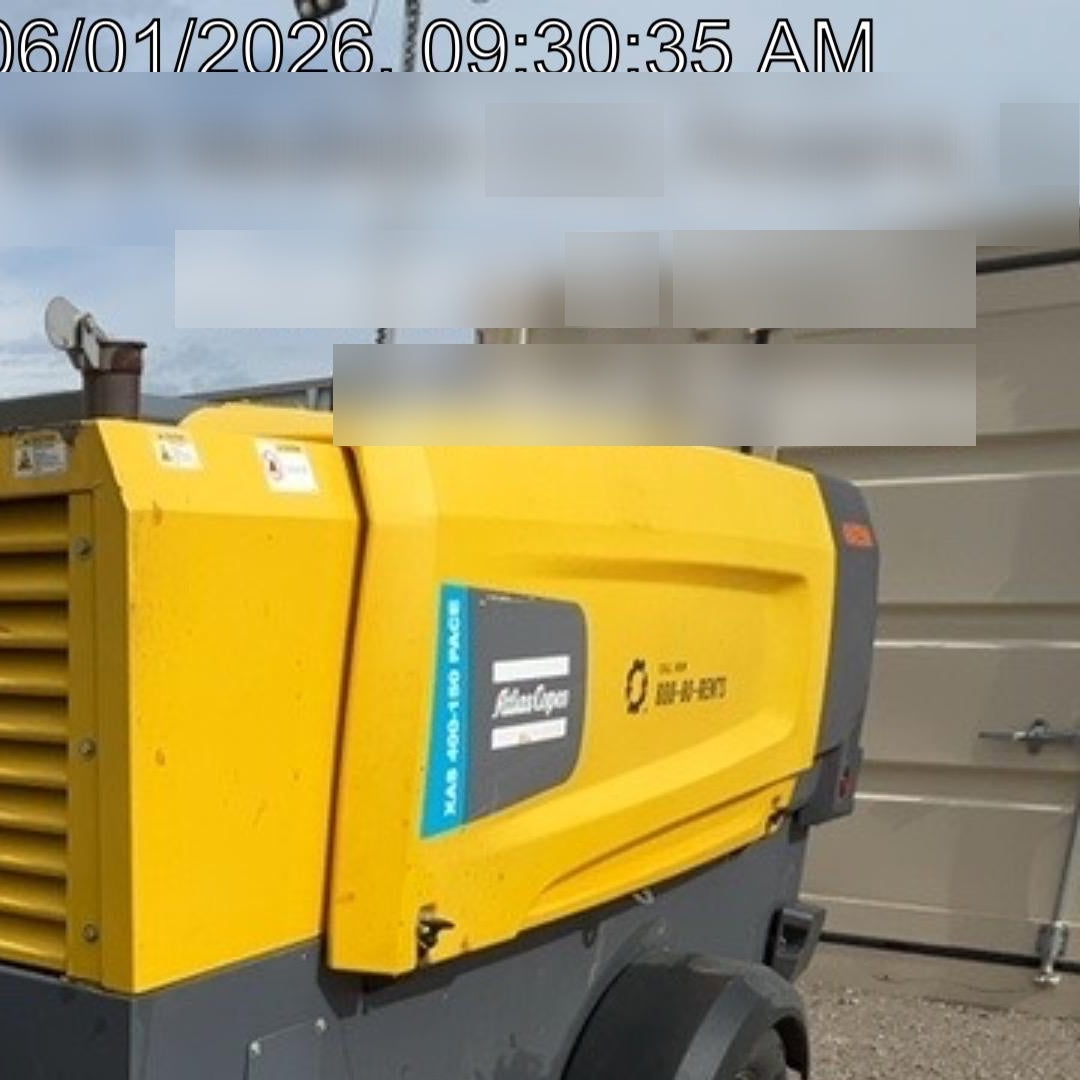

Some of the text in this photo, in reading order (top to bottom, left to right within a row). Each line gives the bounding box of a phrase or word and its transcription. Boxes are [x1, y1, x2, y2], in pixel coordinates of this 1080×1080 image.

[444, 599, 461, 817] XAS 400-150 PACE
[491, 684, 569, 720] Atlas Copco
